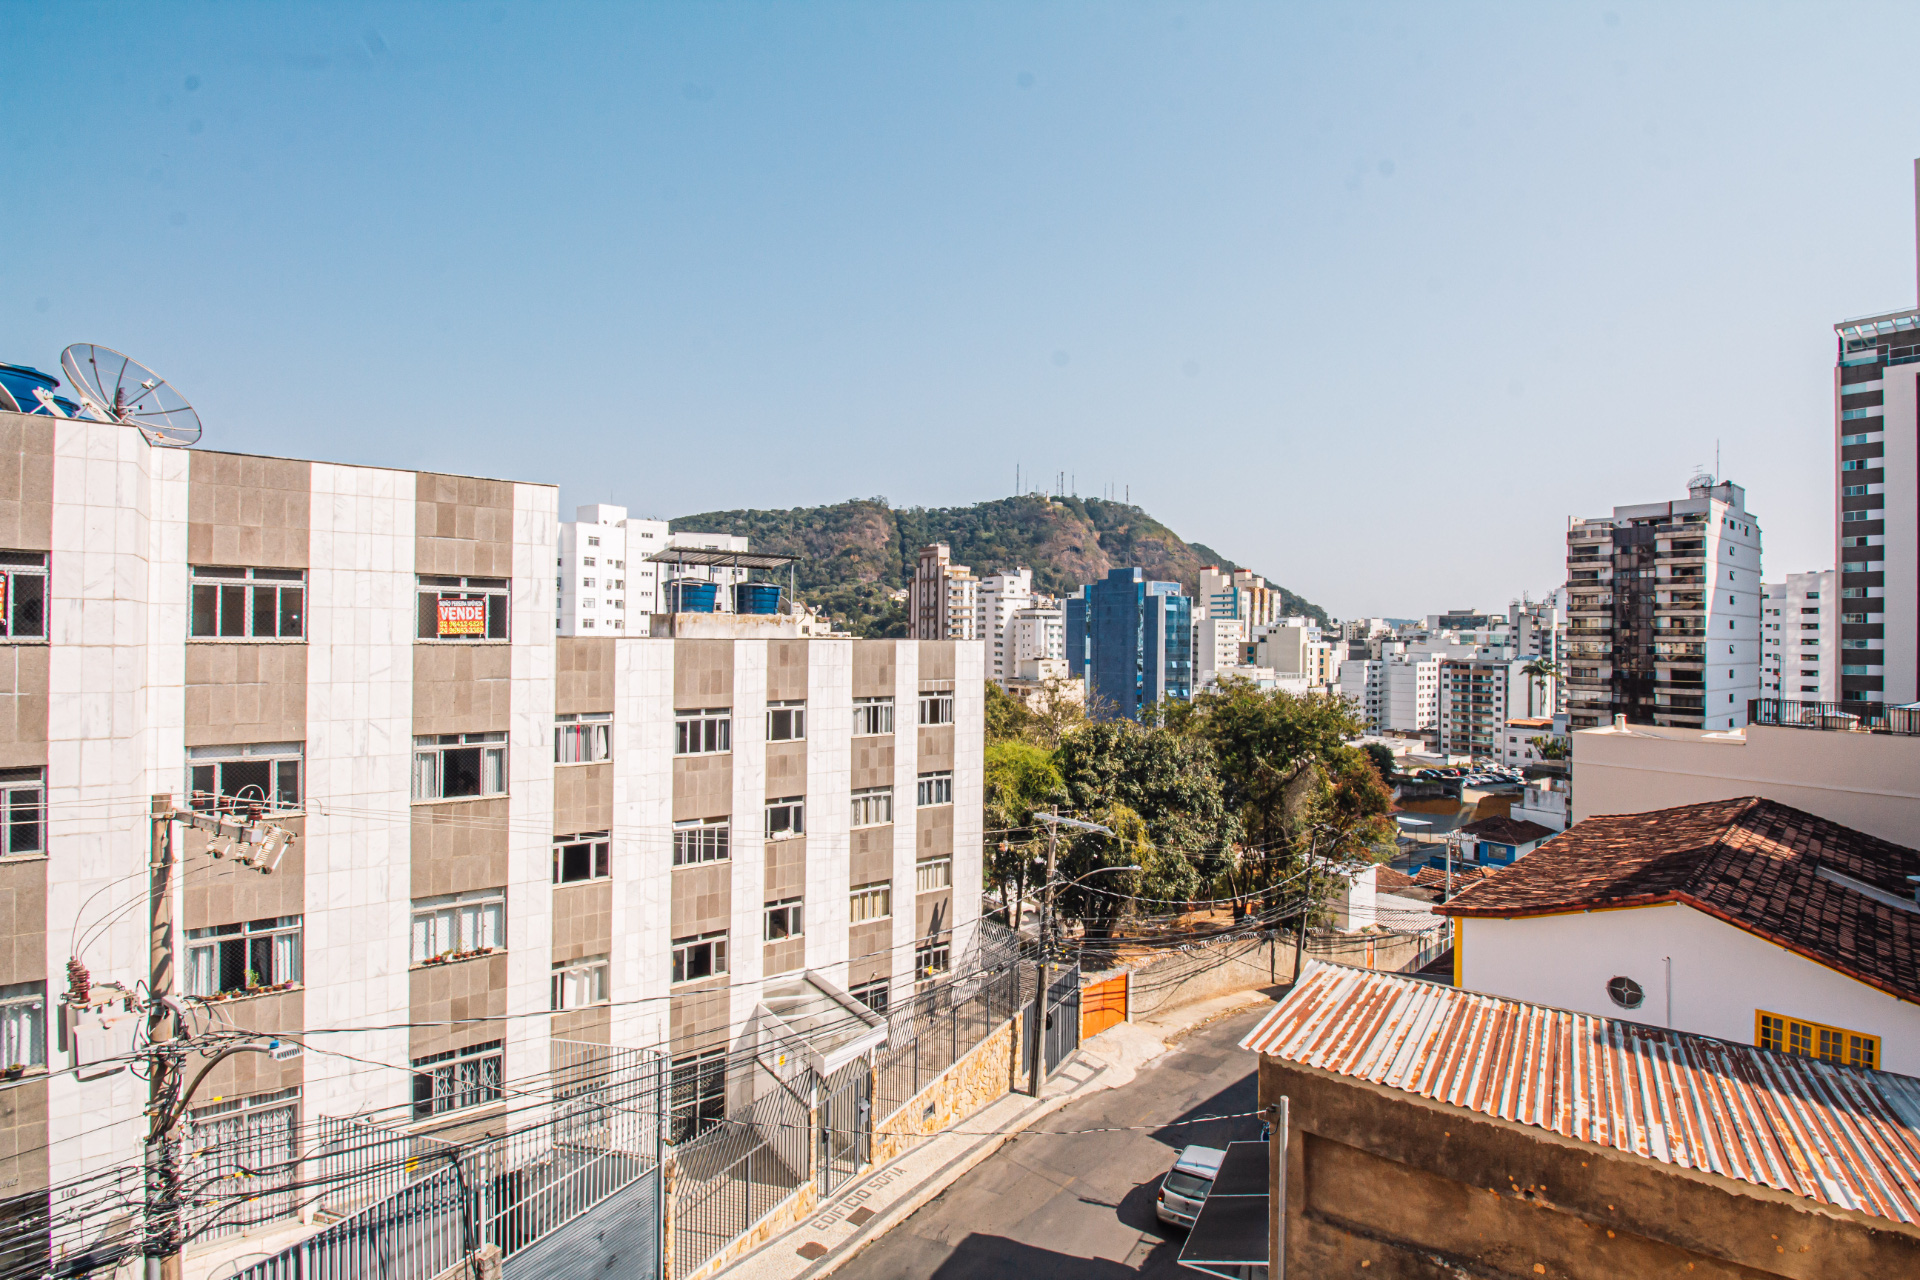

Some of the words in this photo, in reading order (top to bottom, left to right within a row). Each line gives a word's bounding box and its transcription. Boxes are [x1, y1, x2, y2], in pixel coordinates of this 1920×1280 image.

[440, 607, 483, 620] VENDE
[61, 1187, 78, 1199] 110
[810, 1188, 872, 1231] EDIFICIO
[867, 1167, 907, 1190] SOFIA
